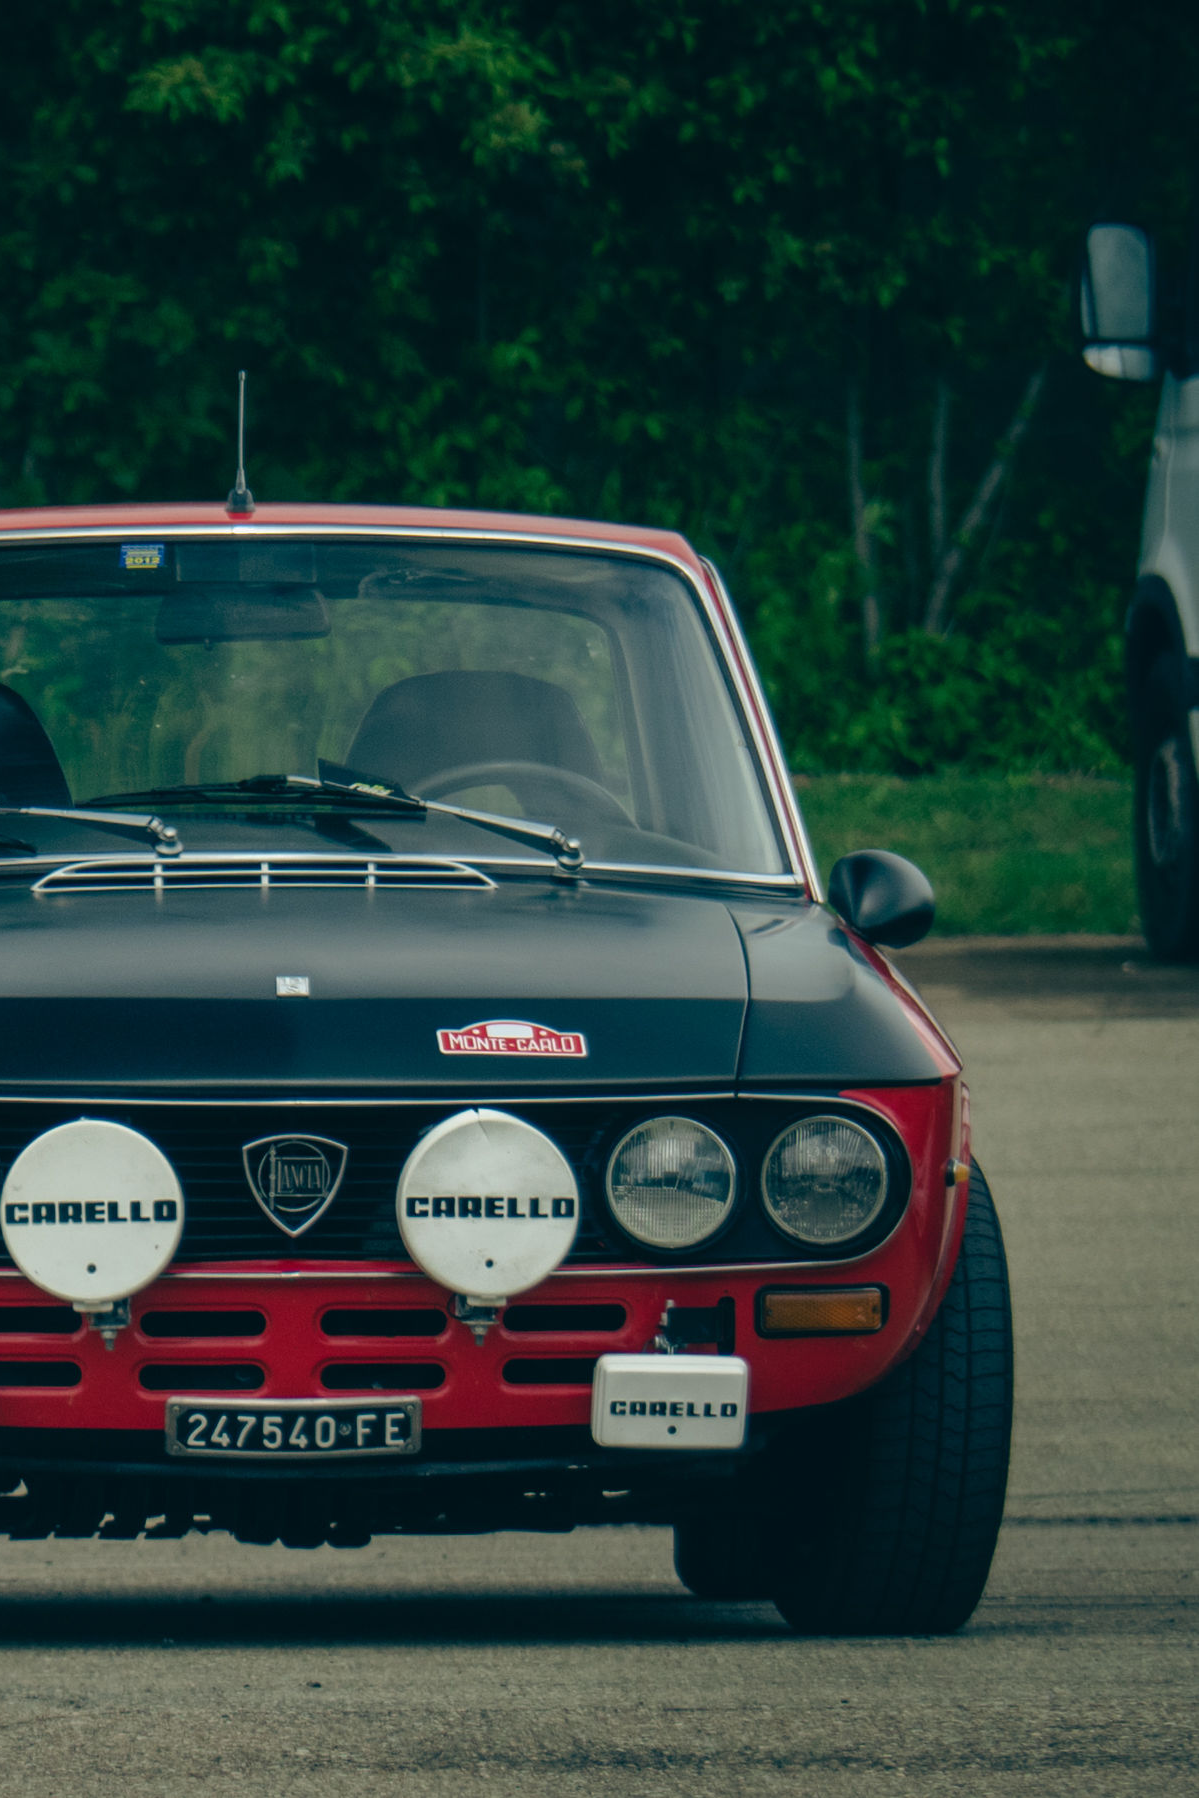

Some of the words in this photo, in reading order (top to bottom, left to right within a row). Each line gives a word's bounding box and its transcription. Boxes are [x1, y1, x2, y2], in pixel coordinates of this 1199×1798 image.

[277, 1160, 321, 1193] LANCIA
[5, 1200, 177, 1225] CARELLO
[406, 1196, 574, 1219] CARELLO
[610, 1401, 738, 1418] CARELLO
[187, 1413, 336, 1449] 247540
[356, 1413, 405, 1447] FE
